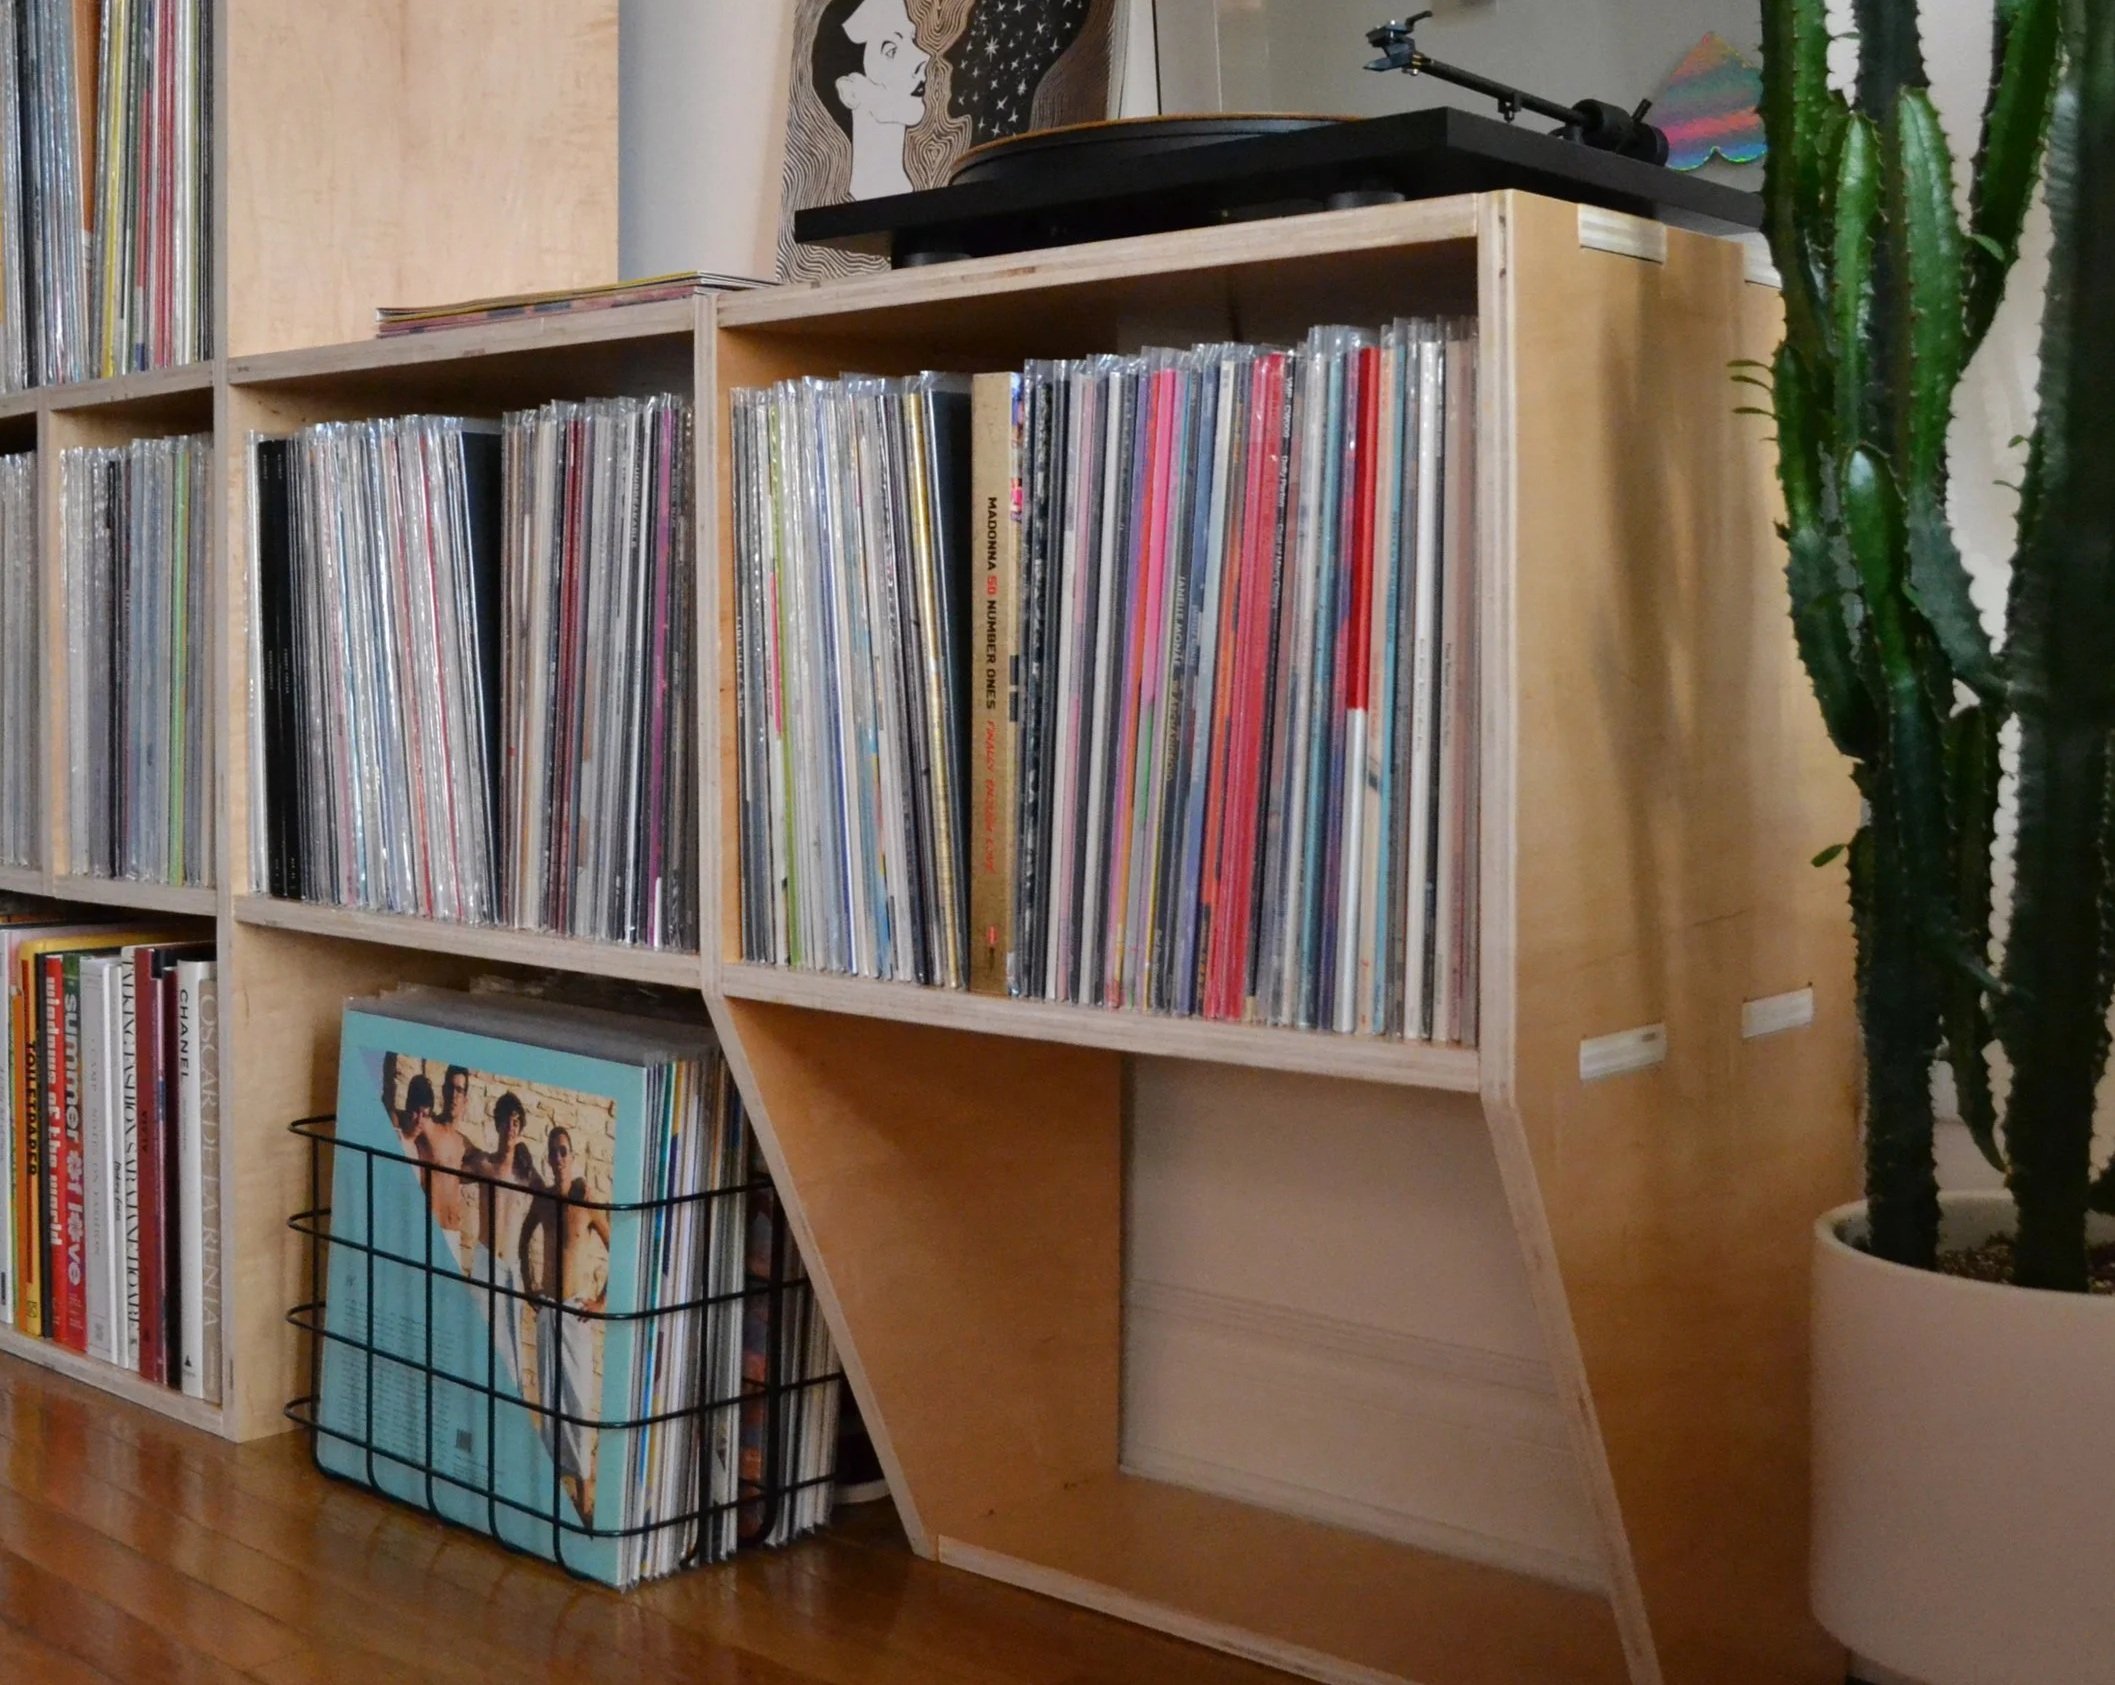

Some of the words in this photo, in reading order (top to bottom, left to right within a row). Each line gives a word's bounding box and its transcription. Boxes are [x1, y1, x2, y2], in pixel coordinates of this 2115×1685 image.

[987, 496, 997, 571] MADONNA
[986, 600, 997, 663] NUMBER
[1175, 575, 1187, 619] JANELLE
[986, 668, 996, 709] ONES
[46, 976, 61, 1084] windows
[180, 988, 189, 1077] CHANEL
[200, 994, 218, 1107] OSCAR
[65, 993, 80, 1142] summer
[122, 1052, 136, 1135] FASHION
[26, 1040, 39, 1175] TOILETPAPER
[47, 1091, 61, 1119] of
[48, 1126, 62, 1168] the
[202, 1121, 219, 1161] DE
[50, 1175, 63, 1245] world
[202, 1175, 219, 1210] LA
